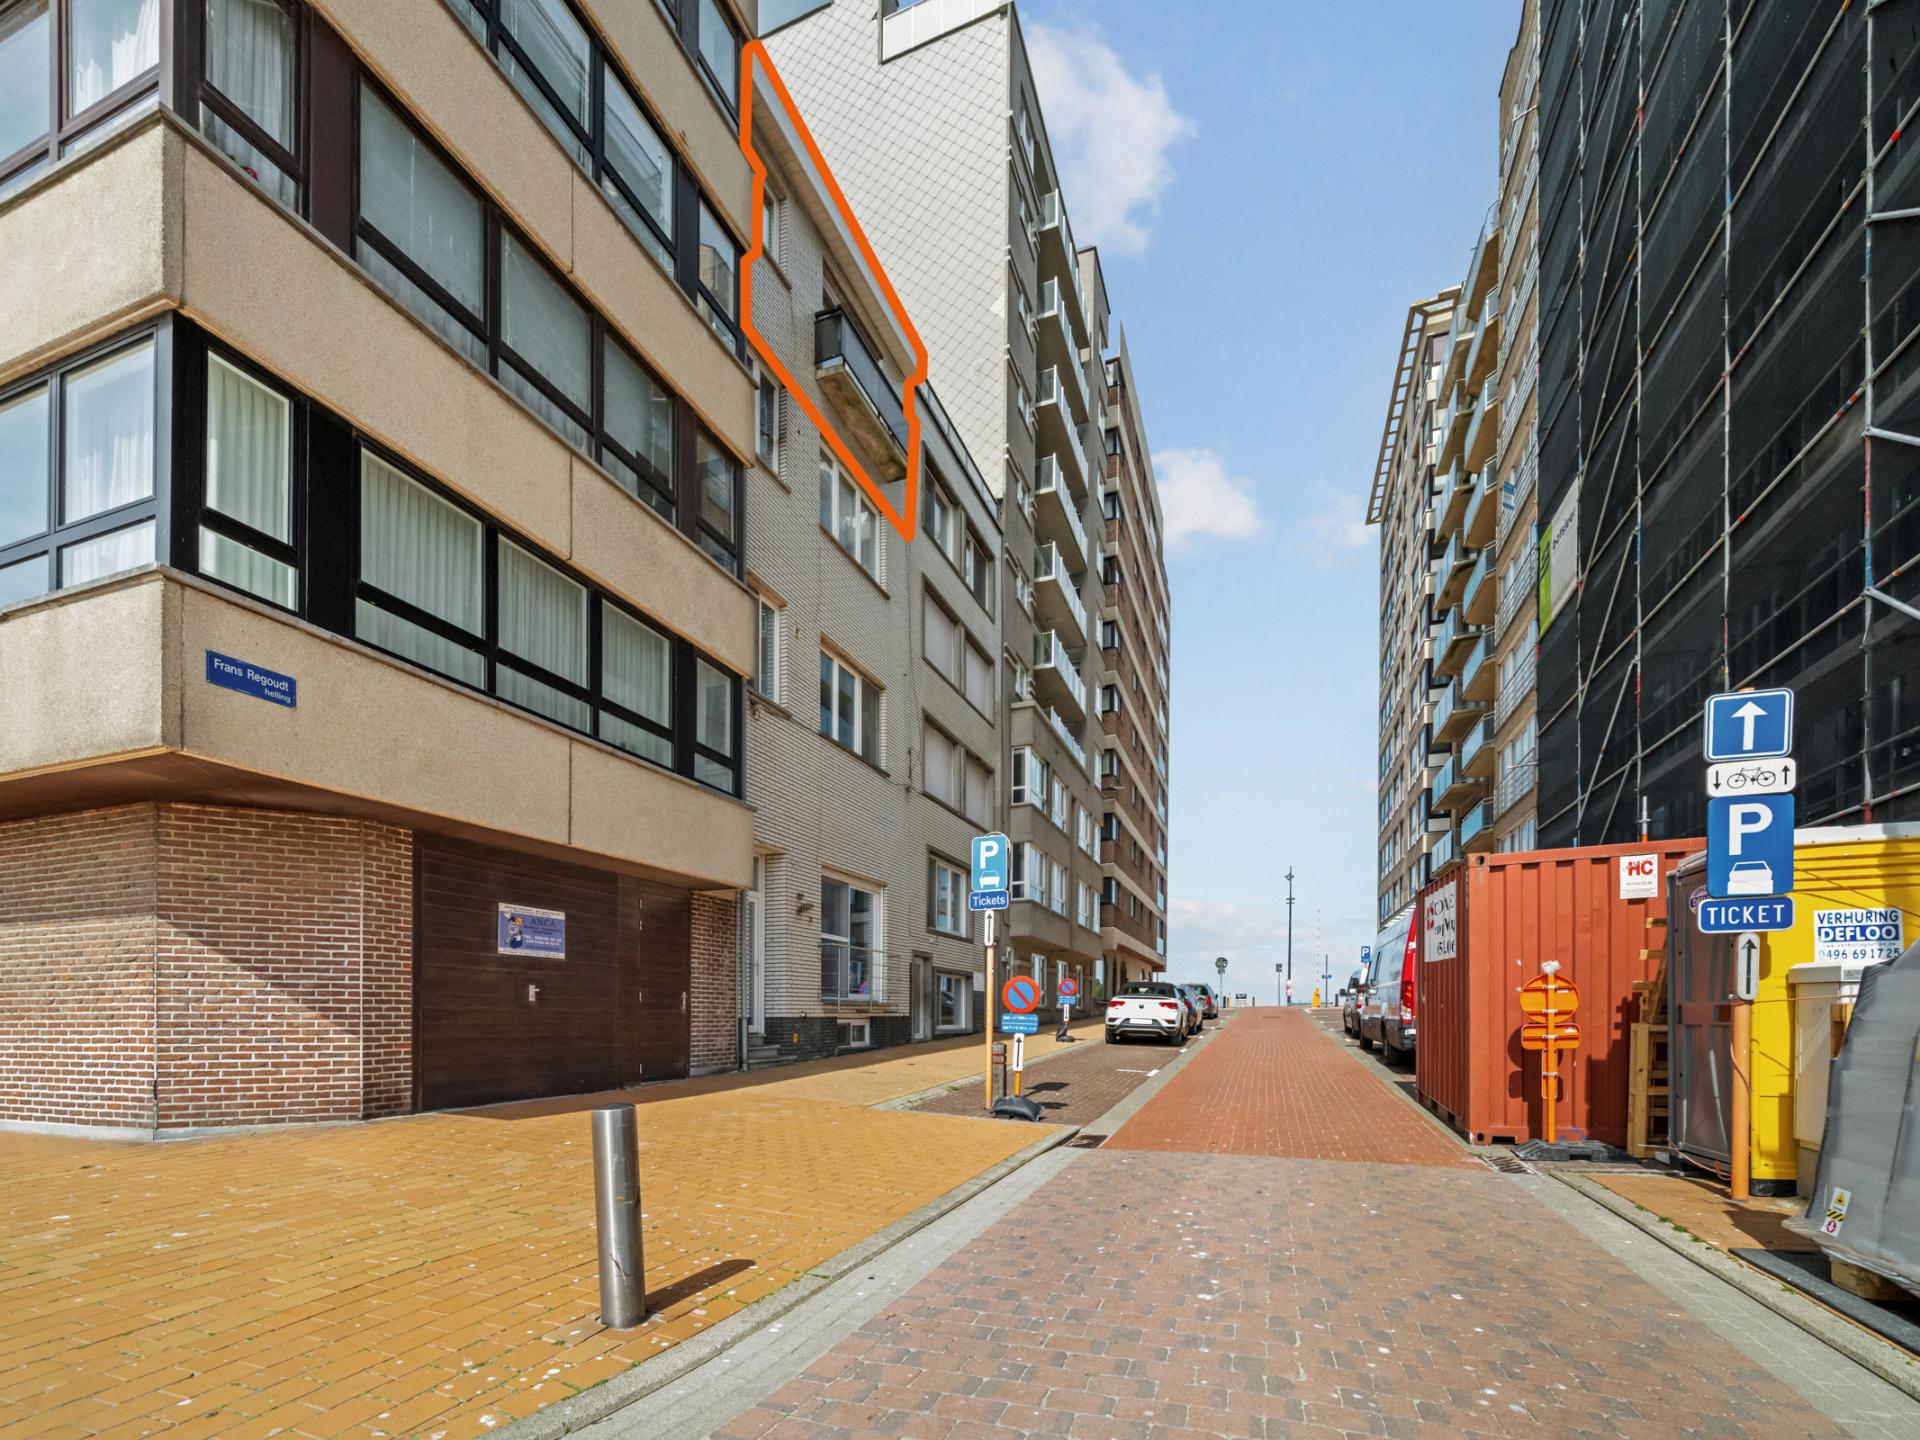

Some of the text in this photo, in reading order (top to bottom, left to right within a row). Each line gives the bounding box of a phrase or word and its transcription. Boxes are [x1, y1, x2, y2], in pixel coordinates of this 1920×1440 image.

[214, 658, 289, 692] Frans Regoudt
[264, 688, 291, 704] helling
[1728, 802, 1773, 856] P
[980, 840, 999, 869] P
[1628, 860, 1653, 876] HC
[972, 894, 1006, 907] Tickets
[1707, 904, 1785, 926] TICKET
[1817, 909, 1899, 925] VERHURING
[1820, 925, 1897, 941] DEFLOO
[1362, 947, 1369, 957] P
[1852, 949, 1867, 960] 69
[1870, 948, 1884, 959] 17
